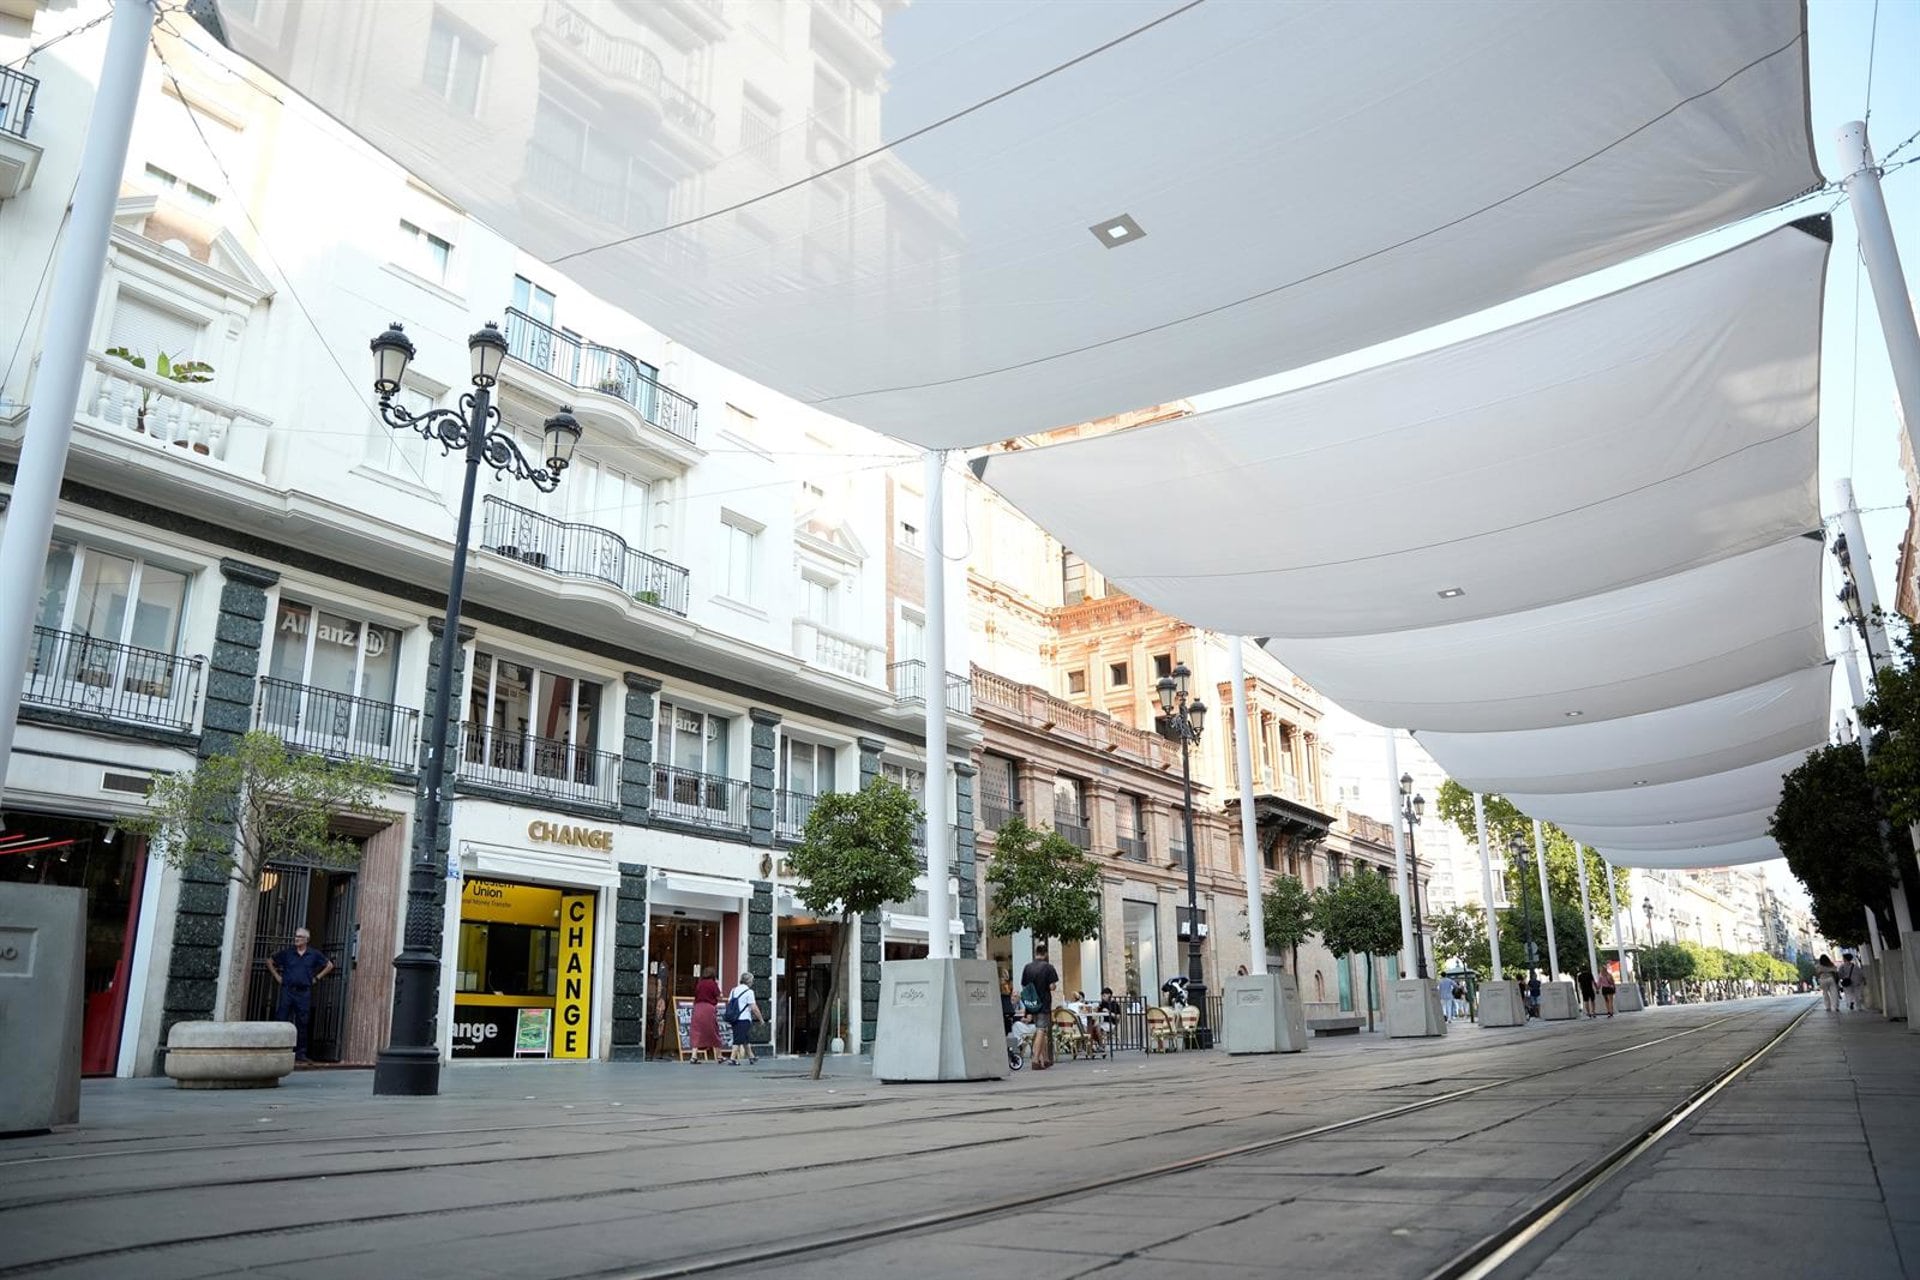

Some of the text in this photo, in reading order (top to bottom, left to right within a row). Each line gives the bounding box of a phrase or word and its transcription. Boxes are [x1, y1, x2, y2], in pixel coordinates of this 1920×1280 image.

[281, 611, 355, 646] Allanz
[528, 820, 613, 851] CHANGE
[473, 885, 503, 898] Union
[564, 901, 585, 1052] CHANGE
